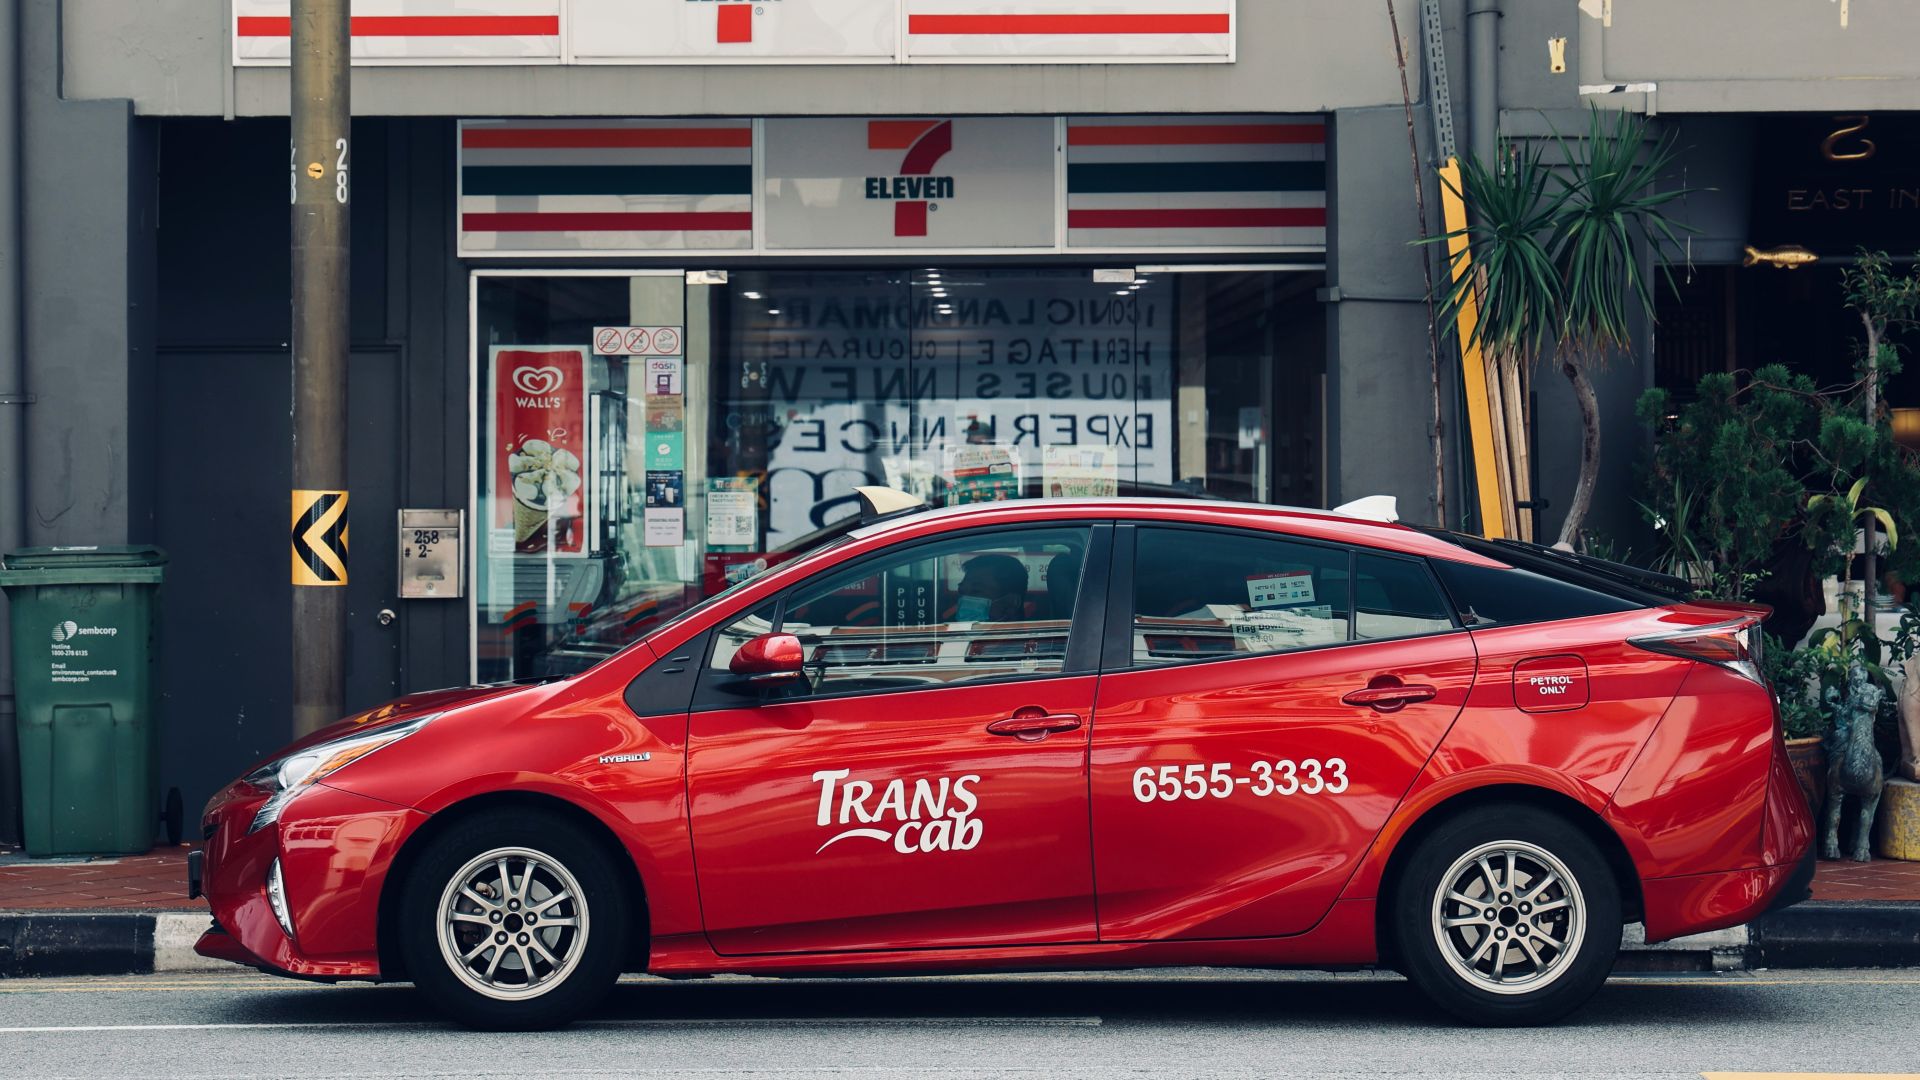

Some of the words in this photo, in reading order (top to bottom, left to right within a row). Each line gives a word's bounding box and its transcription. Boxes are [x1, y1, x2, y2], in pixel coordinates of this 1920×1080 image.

[335, 138, 348, 204] 28
[868, 119, 952, 237] 7
[1788, 188, 1872, 210] EAST
[652, 361, 676, 370] dash
[515, 397, 561, 409] WALL'S
[414, 529, 440, 544] 258
[78, 626, 118, 636] sembcorp
[1236, 625, 1256, 633] Flag
[1530, 676, 1573, 685] PETROL
[1539, 685, 1566, 695] ONLY
[600, 754, 643, 764] HYBRID
[1132, 757, 1349, 803] 6555-3333
[894, 806, 983, 854] cab
